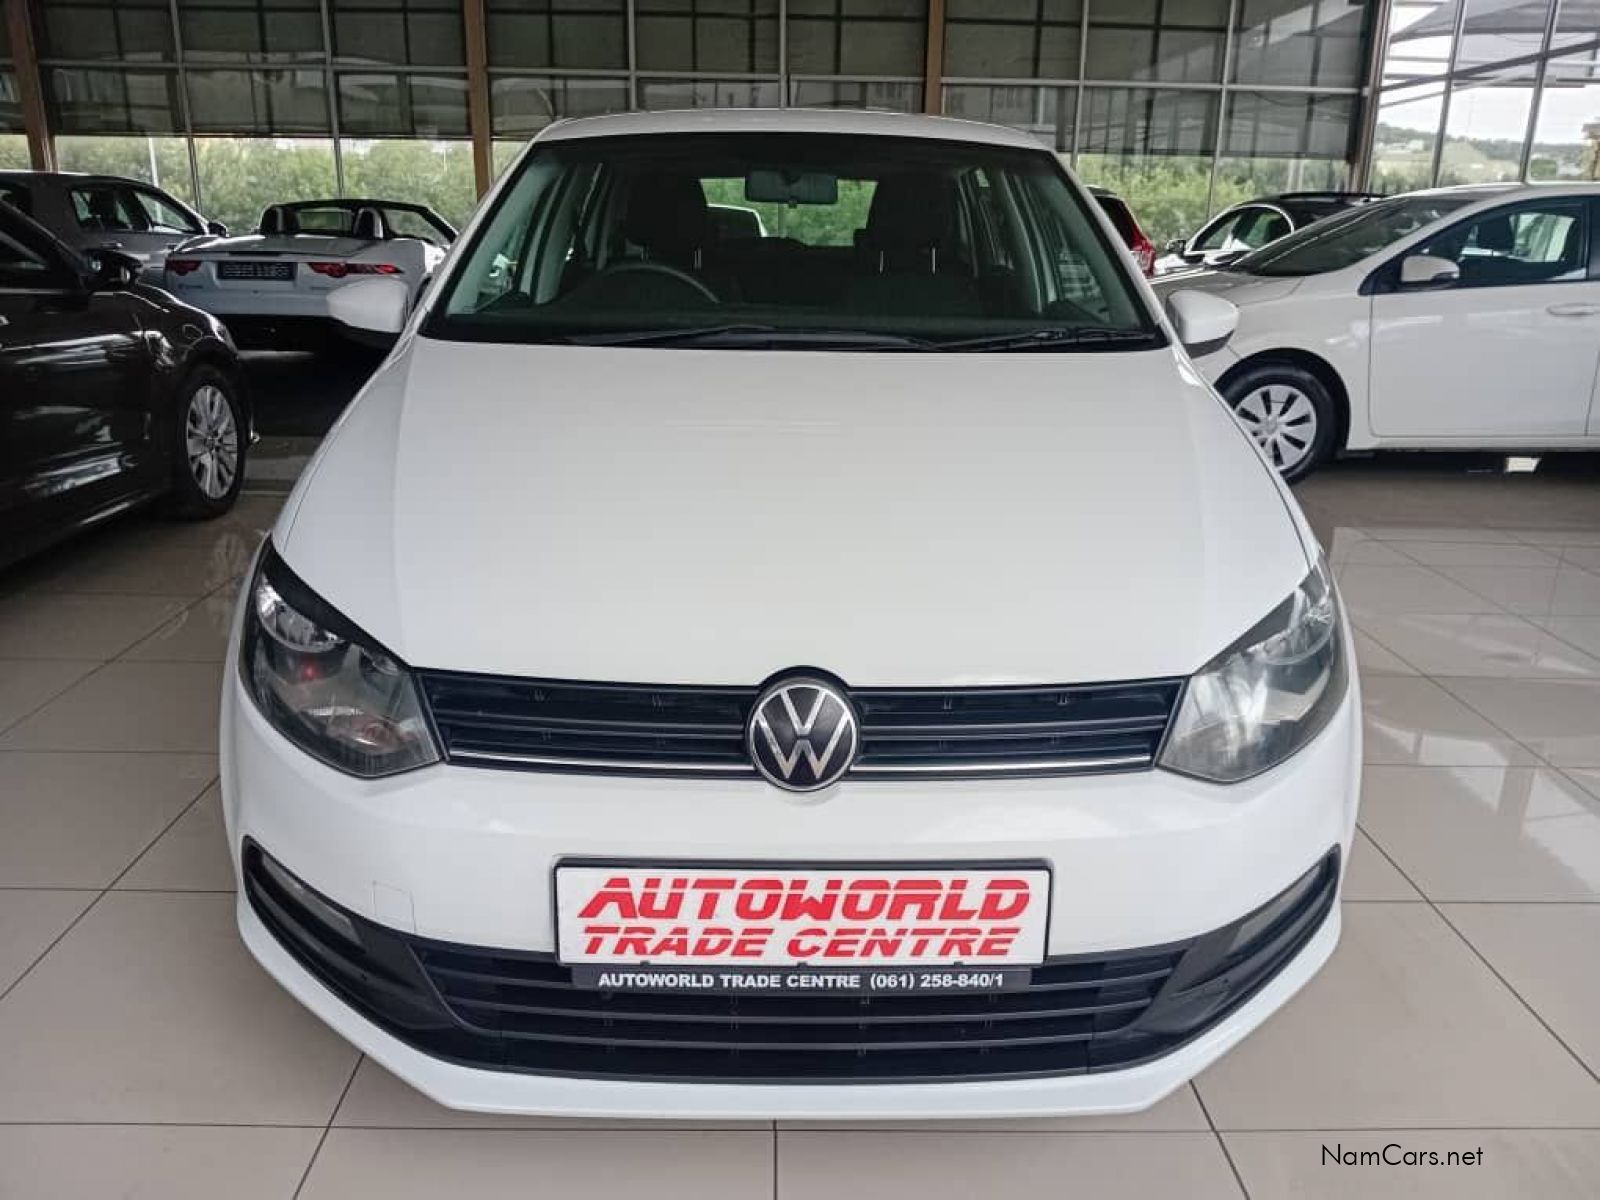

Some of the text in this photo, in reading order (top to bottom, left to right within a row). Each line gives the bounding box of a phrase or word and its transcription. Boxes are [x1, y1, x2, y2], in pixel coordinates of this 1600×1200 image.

[754, 686, 853, 782] VW
[577, 876, 1030, 921] AUTOWORLD
[584, 925, 1021, 958] TRADE CENTRE
[598, 973, 1004, 991] AUTOWORLD TRADE CENTRE (061) 258-840/1
